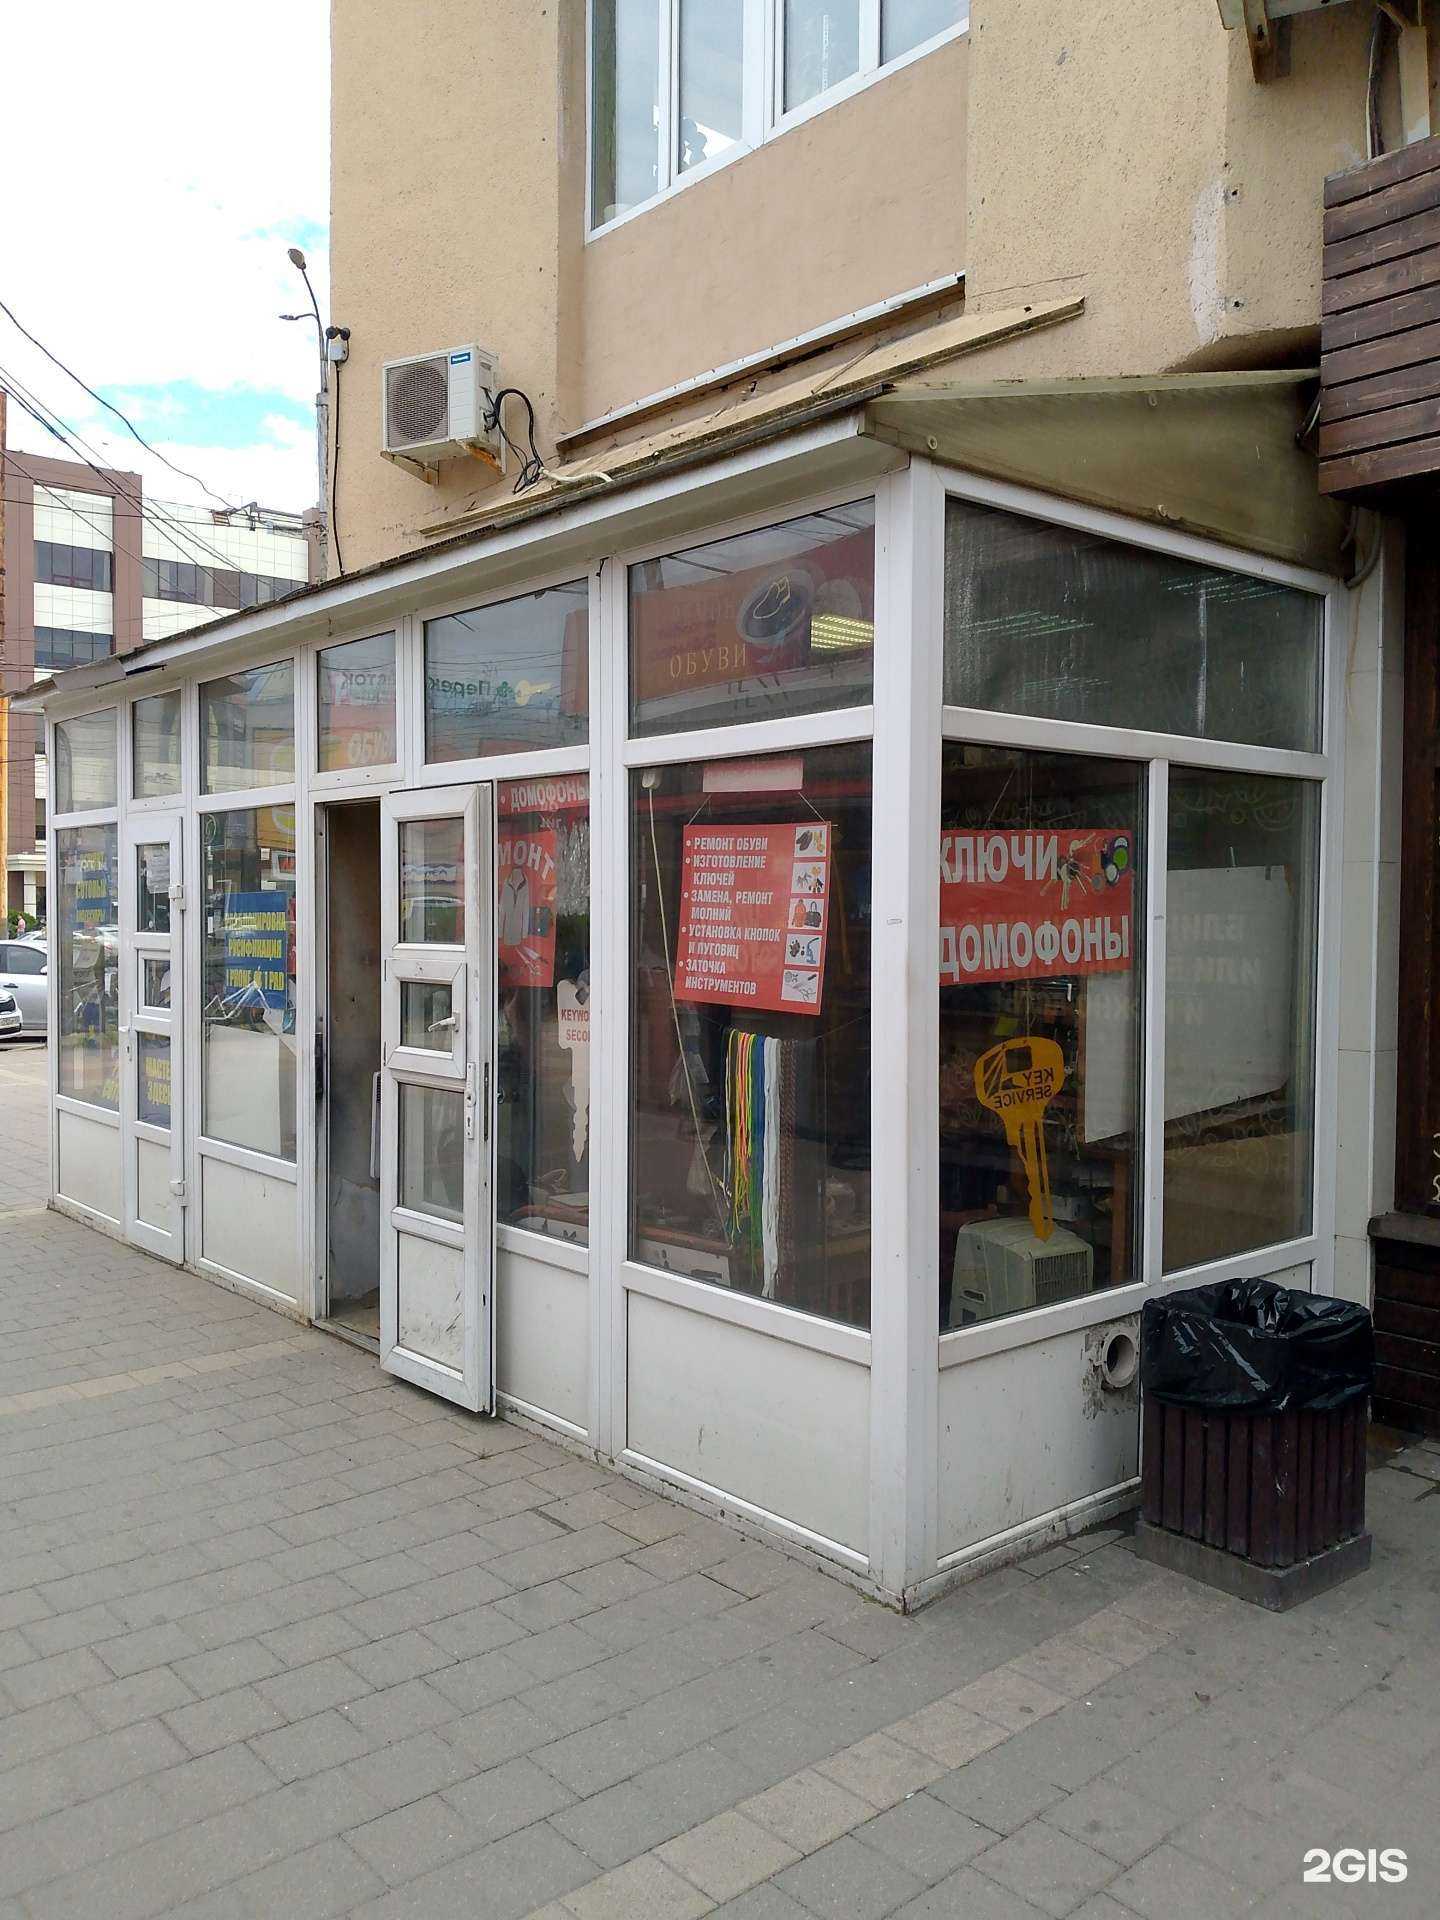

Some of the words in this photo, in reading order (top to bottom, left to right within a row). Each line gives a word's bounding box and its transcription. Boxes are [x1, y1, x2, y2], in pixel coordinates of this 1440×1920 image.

[670, 643, 747, 681] ОБУВИ
[694, 837, 735, 851] РЕМОНТ
[736, 837, 768, 851] ОБУВИ
[693, 854, 767, 869] ИЗГОТОВЛЕНИЕ
[941, 835, 1058, 884] КЛЮЧИ
[693, 870, 736, 886] КЛЮЧЕЙ
[691, 890, 733, 905] ЗАМЕНА,
[735, 891, 774, 905] РЕМОНТ
[691, 905, 732, 921] МОЛНИЙ
[688, 924, 742, 941] УСТАНОВКА
[744, 927, 781, 942] КНОПОК
[688, 942, 696, 954] И
[697, 943, 740, 959] ПУГОВИЦ
[939, 915, 1130, 982] ДОМОФОНЫ
[685, 959, 726, 974] ЗАТОЧКА
[685, 977, 757, 995] ИНСТРУМЕНТОВ
